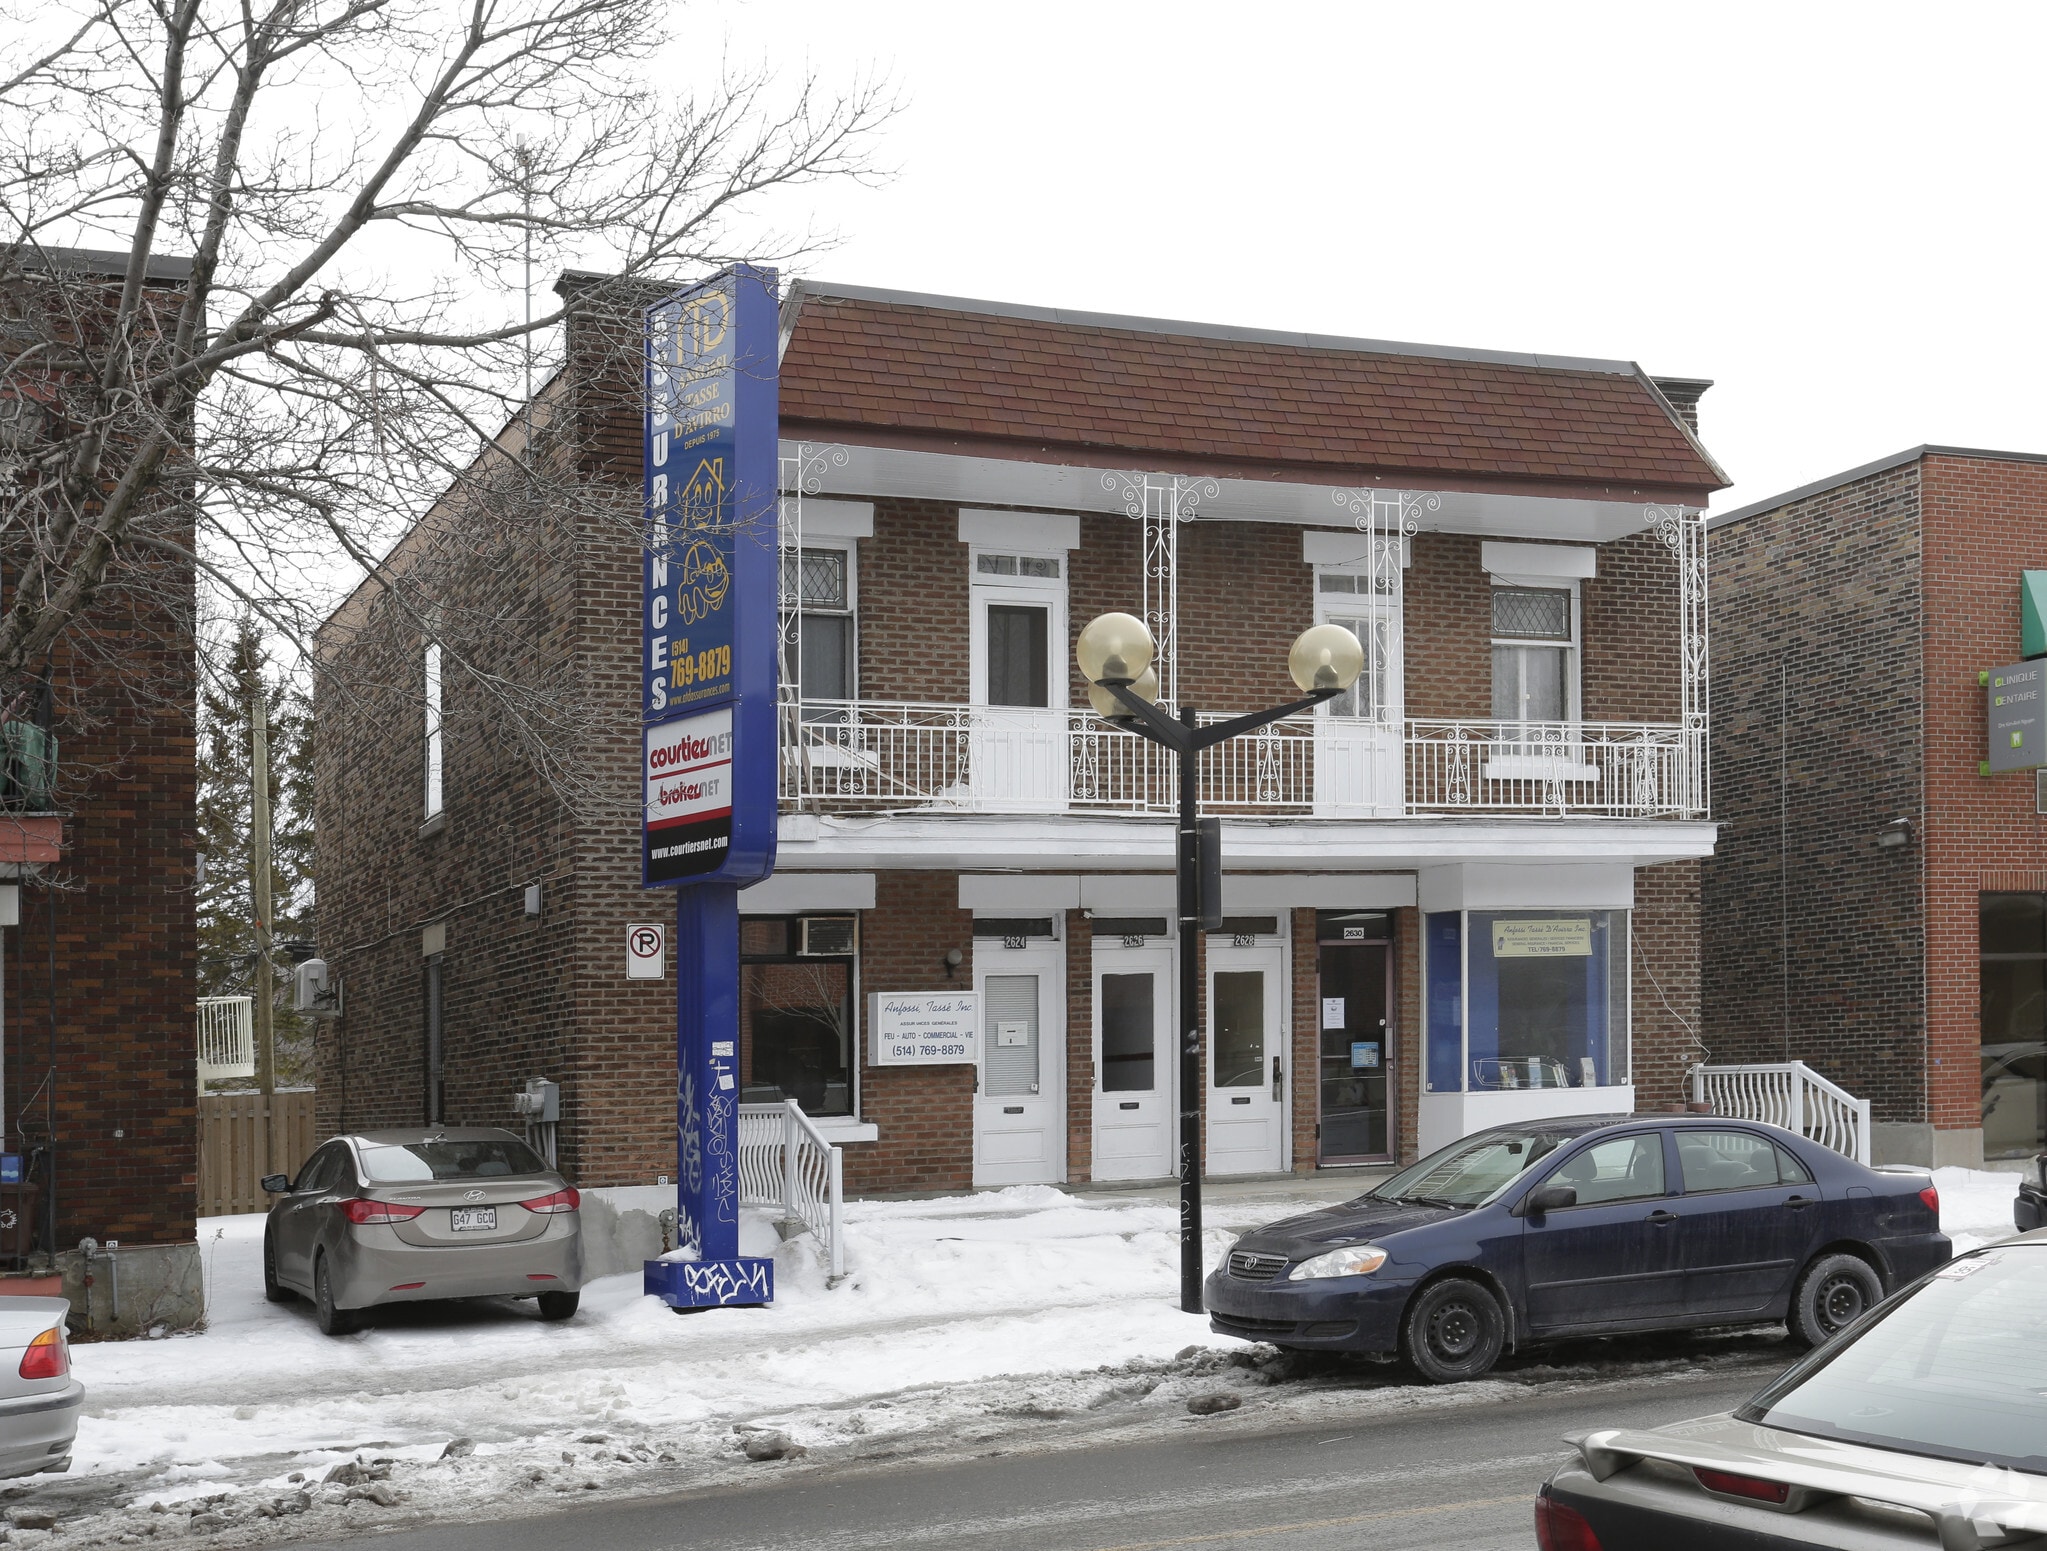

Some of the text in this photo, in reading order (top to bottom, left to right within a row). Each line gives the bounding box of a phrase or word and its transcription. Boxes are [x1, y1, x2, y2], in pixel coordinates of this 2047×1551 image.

[684, 429, 720, 450] DEPUIS 1975
[671, 638, 689, 656] (514)
[670, 645, 731, 689] 769-8879
[1995, 670, 2038, 688] CLINIQUE
[1995, 690, 2038, 707] DENTAIRE
[652, 836, 728, 860] www.courtiersnet.com
[1006, 936, 1026, 948] 2624
[1124, 935, 1143, 947] 2626
[1235, 935, 1254, 946] 2628
[926, 1000, 951, 1012] Tassé
[923, 1031, 958, 1039] COMMERCIAL
[892, 1044, 965, 1056] (514) 769-8879
[453, 1213, 471, 1225] G47
